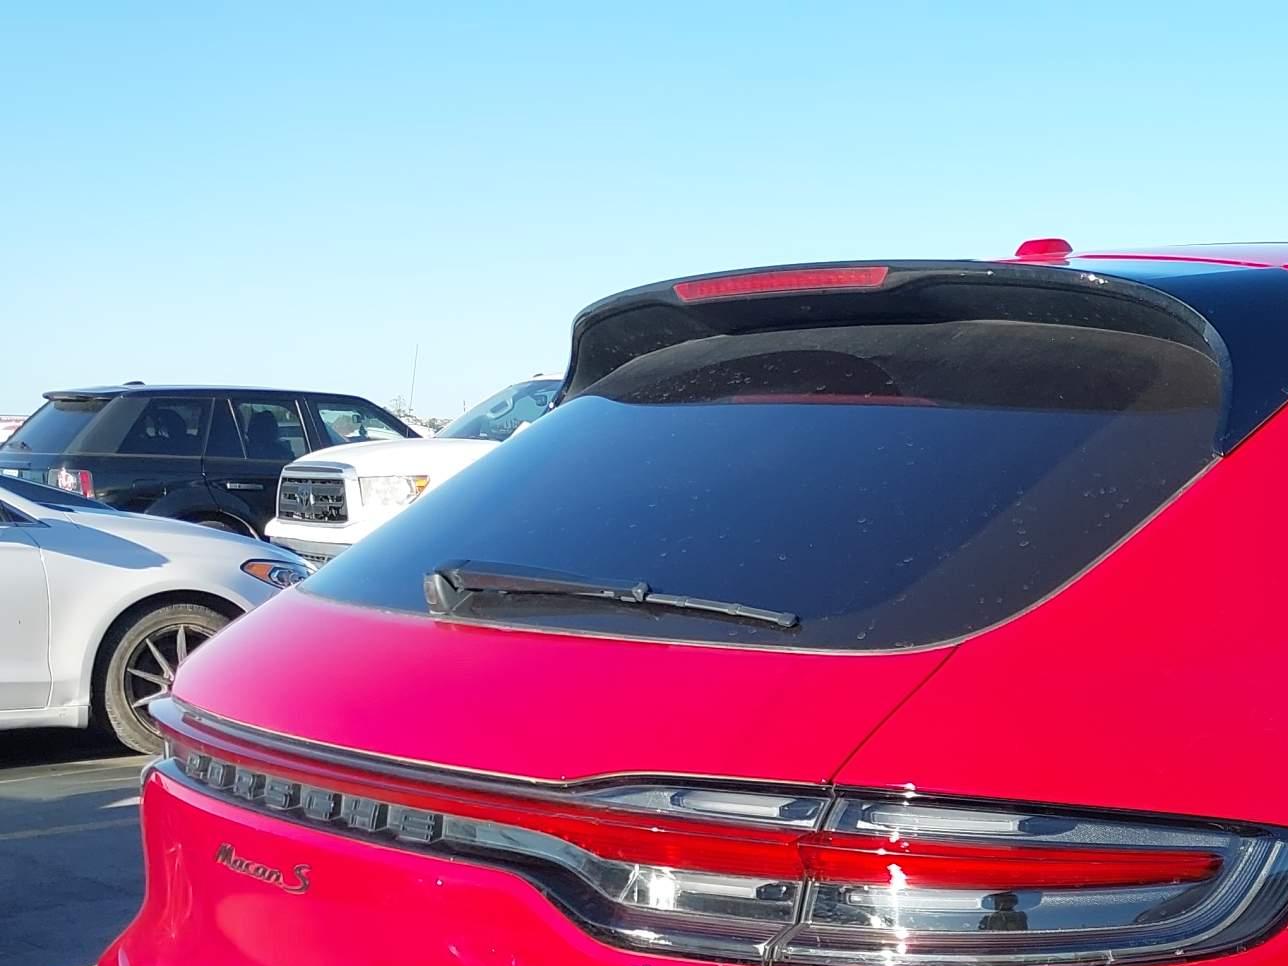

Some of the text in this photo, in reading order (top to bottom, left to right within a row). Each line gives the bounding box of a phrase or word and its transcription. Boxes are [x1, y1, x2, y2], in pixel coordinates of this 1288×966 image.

[184, 751, 442, 844] PORSCHE
[216, 842, 312, 895] Macan S
